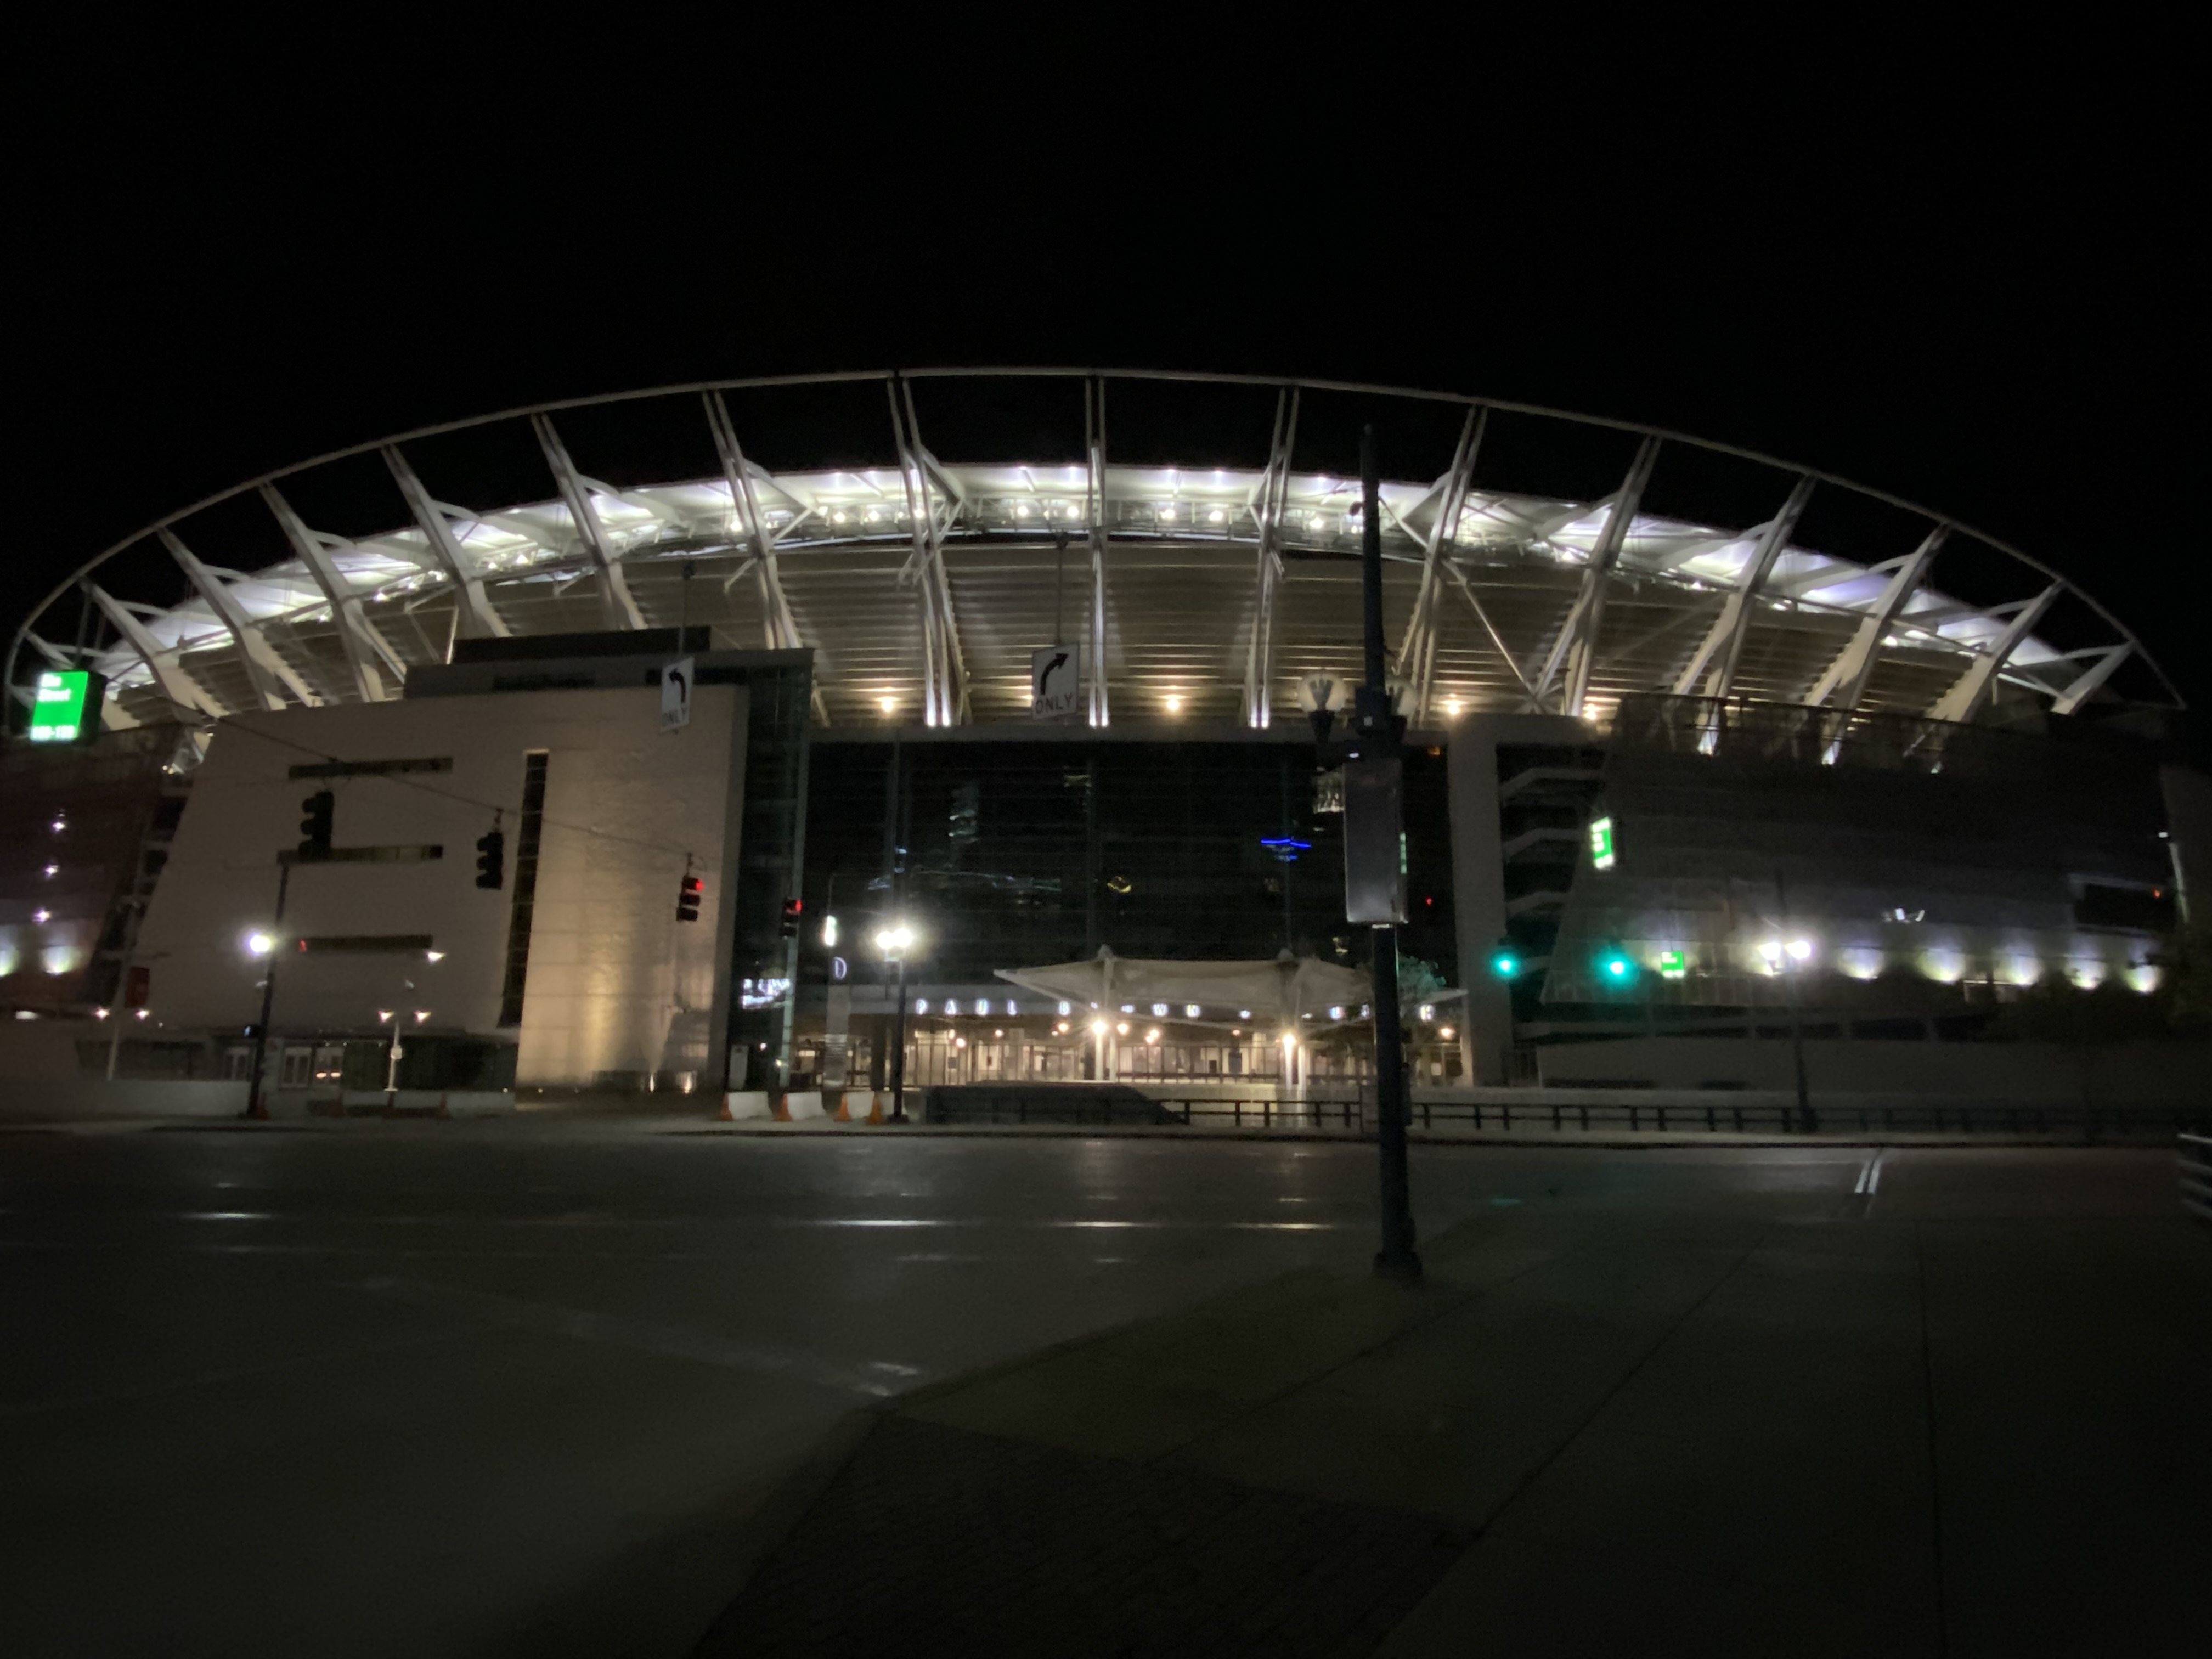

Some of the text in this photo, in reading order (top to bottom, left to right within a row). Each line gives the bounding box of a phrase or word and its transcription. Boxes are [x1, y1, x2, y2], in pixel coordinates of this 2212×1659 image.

[1035, 693, 1073, 715] ONLY
[833, 956, 847, 980] D
[916, 998, 1201, 1018] PAUL BWN
